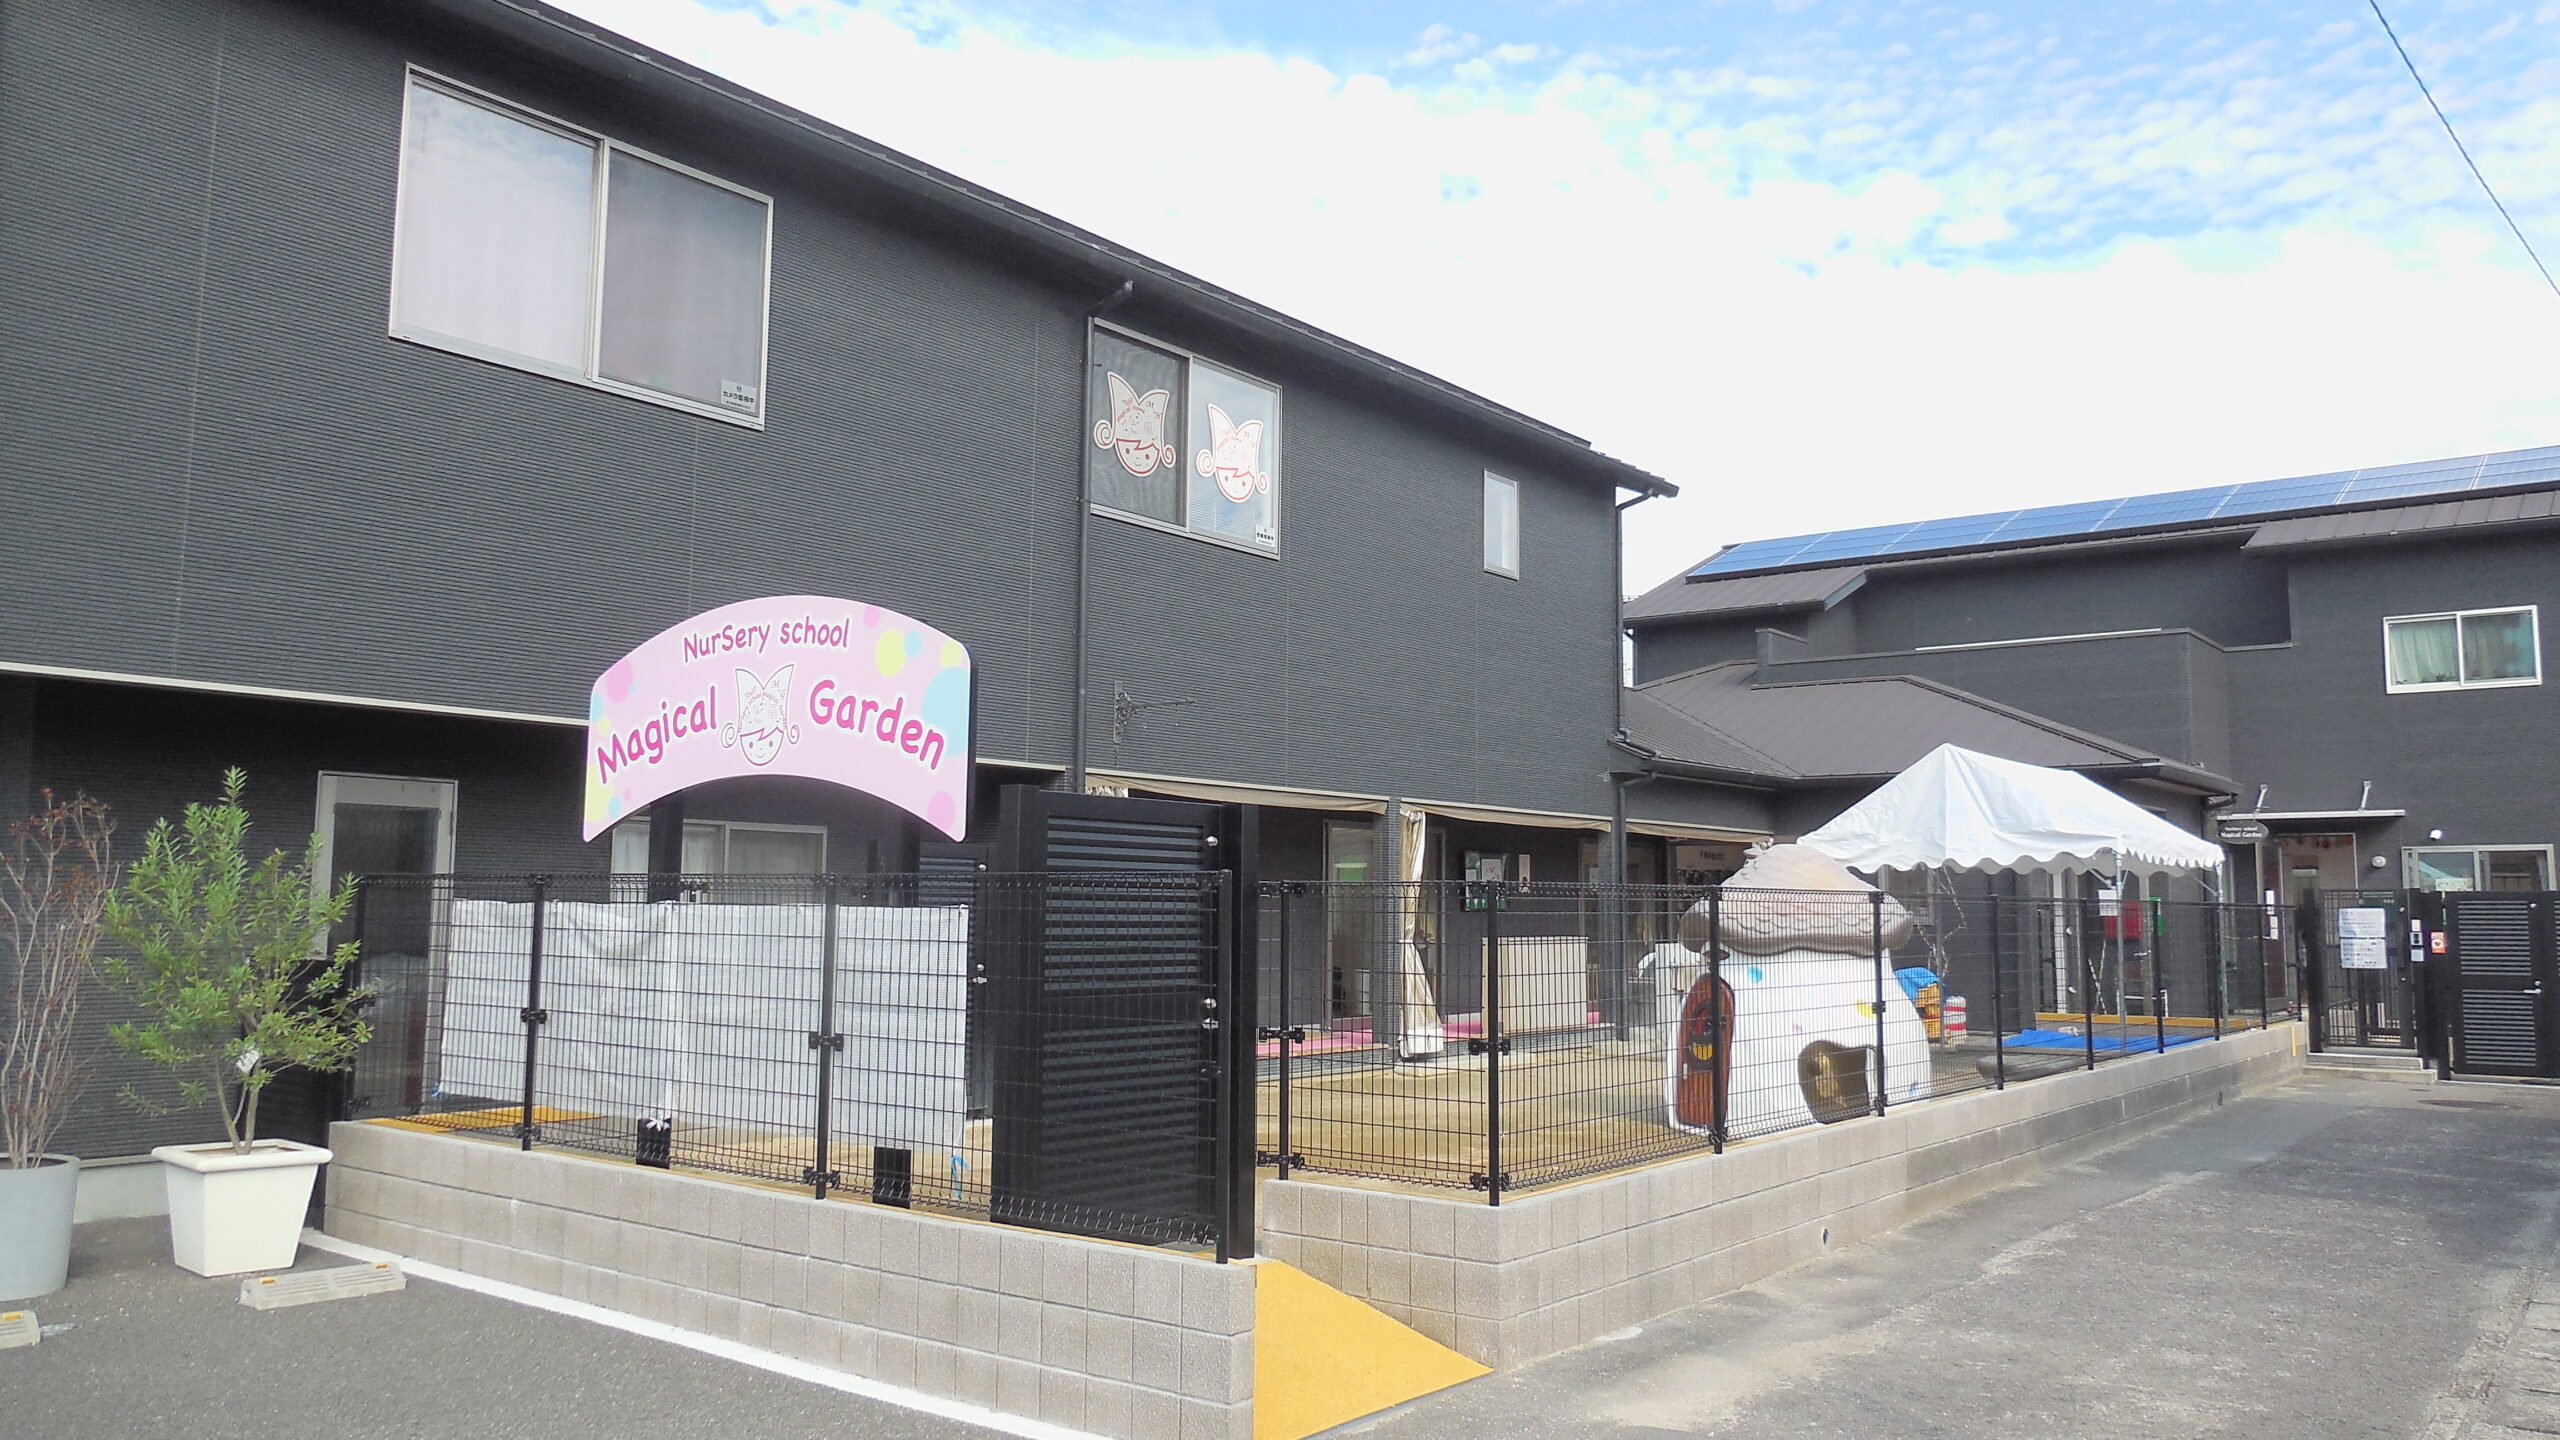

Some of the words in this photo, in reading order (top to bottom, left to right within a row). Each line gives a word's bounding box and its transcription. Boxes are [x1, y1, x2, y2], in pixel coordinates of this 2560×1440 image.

[779, 616, 850, 648] school
[597, 686, 717, 784] Magical
[810, 679, 945, 770] Garden
